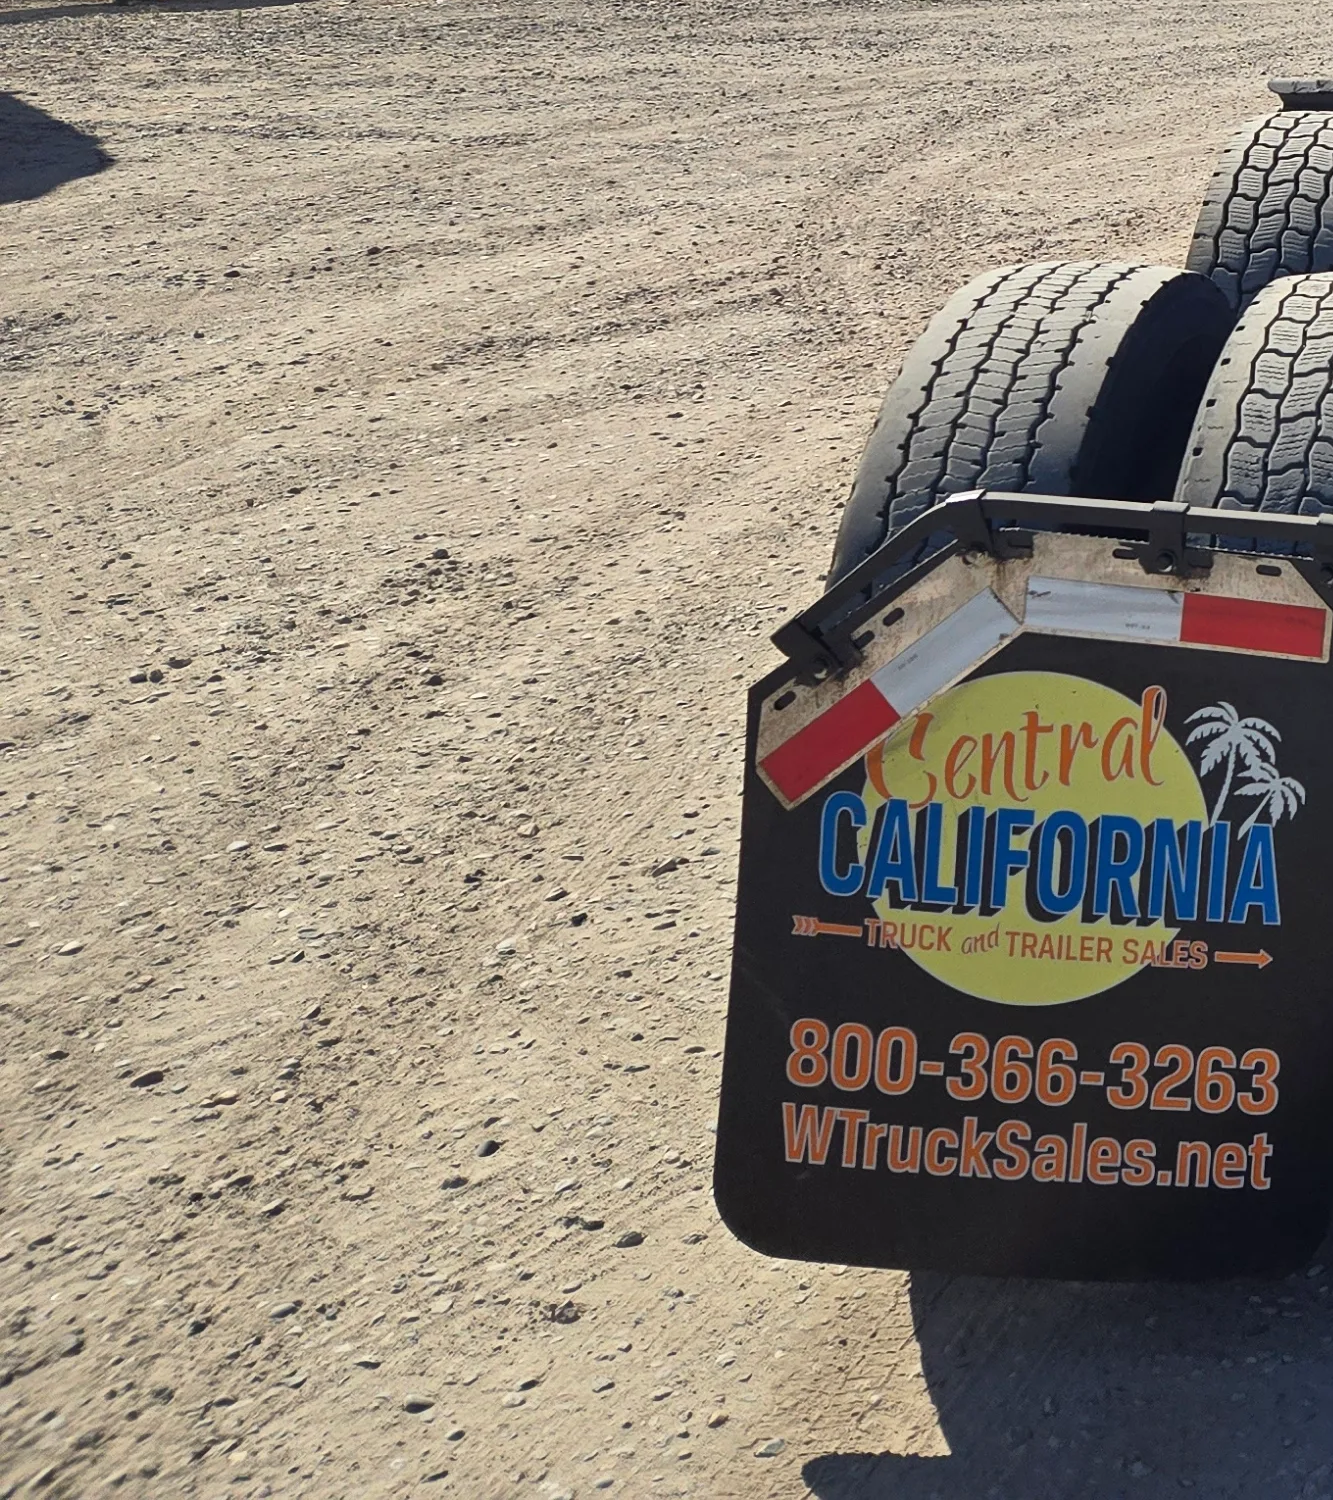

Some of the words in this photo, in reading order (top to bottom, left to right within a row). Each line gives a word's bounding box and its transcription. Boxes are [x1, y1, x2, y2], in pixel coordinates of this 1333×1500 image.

[863, 683, 1169, 812] Central
[816, 789, 1282, 928] CALIFORNIA
[863, 917, 954, 952] TRUCK
[958, 920, 1003, 956] and
[1004, 929, 1114, 964] TRAILER
[1121, 937, 1211, 970] SALES
[784, 1017, 1281, 1116] 800-366-3263
[781, 1101, 1274, 1190] WTruckSales.net
